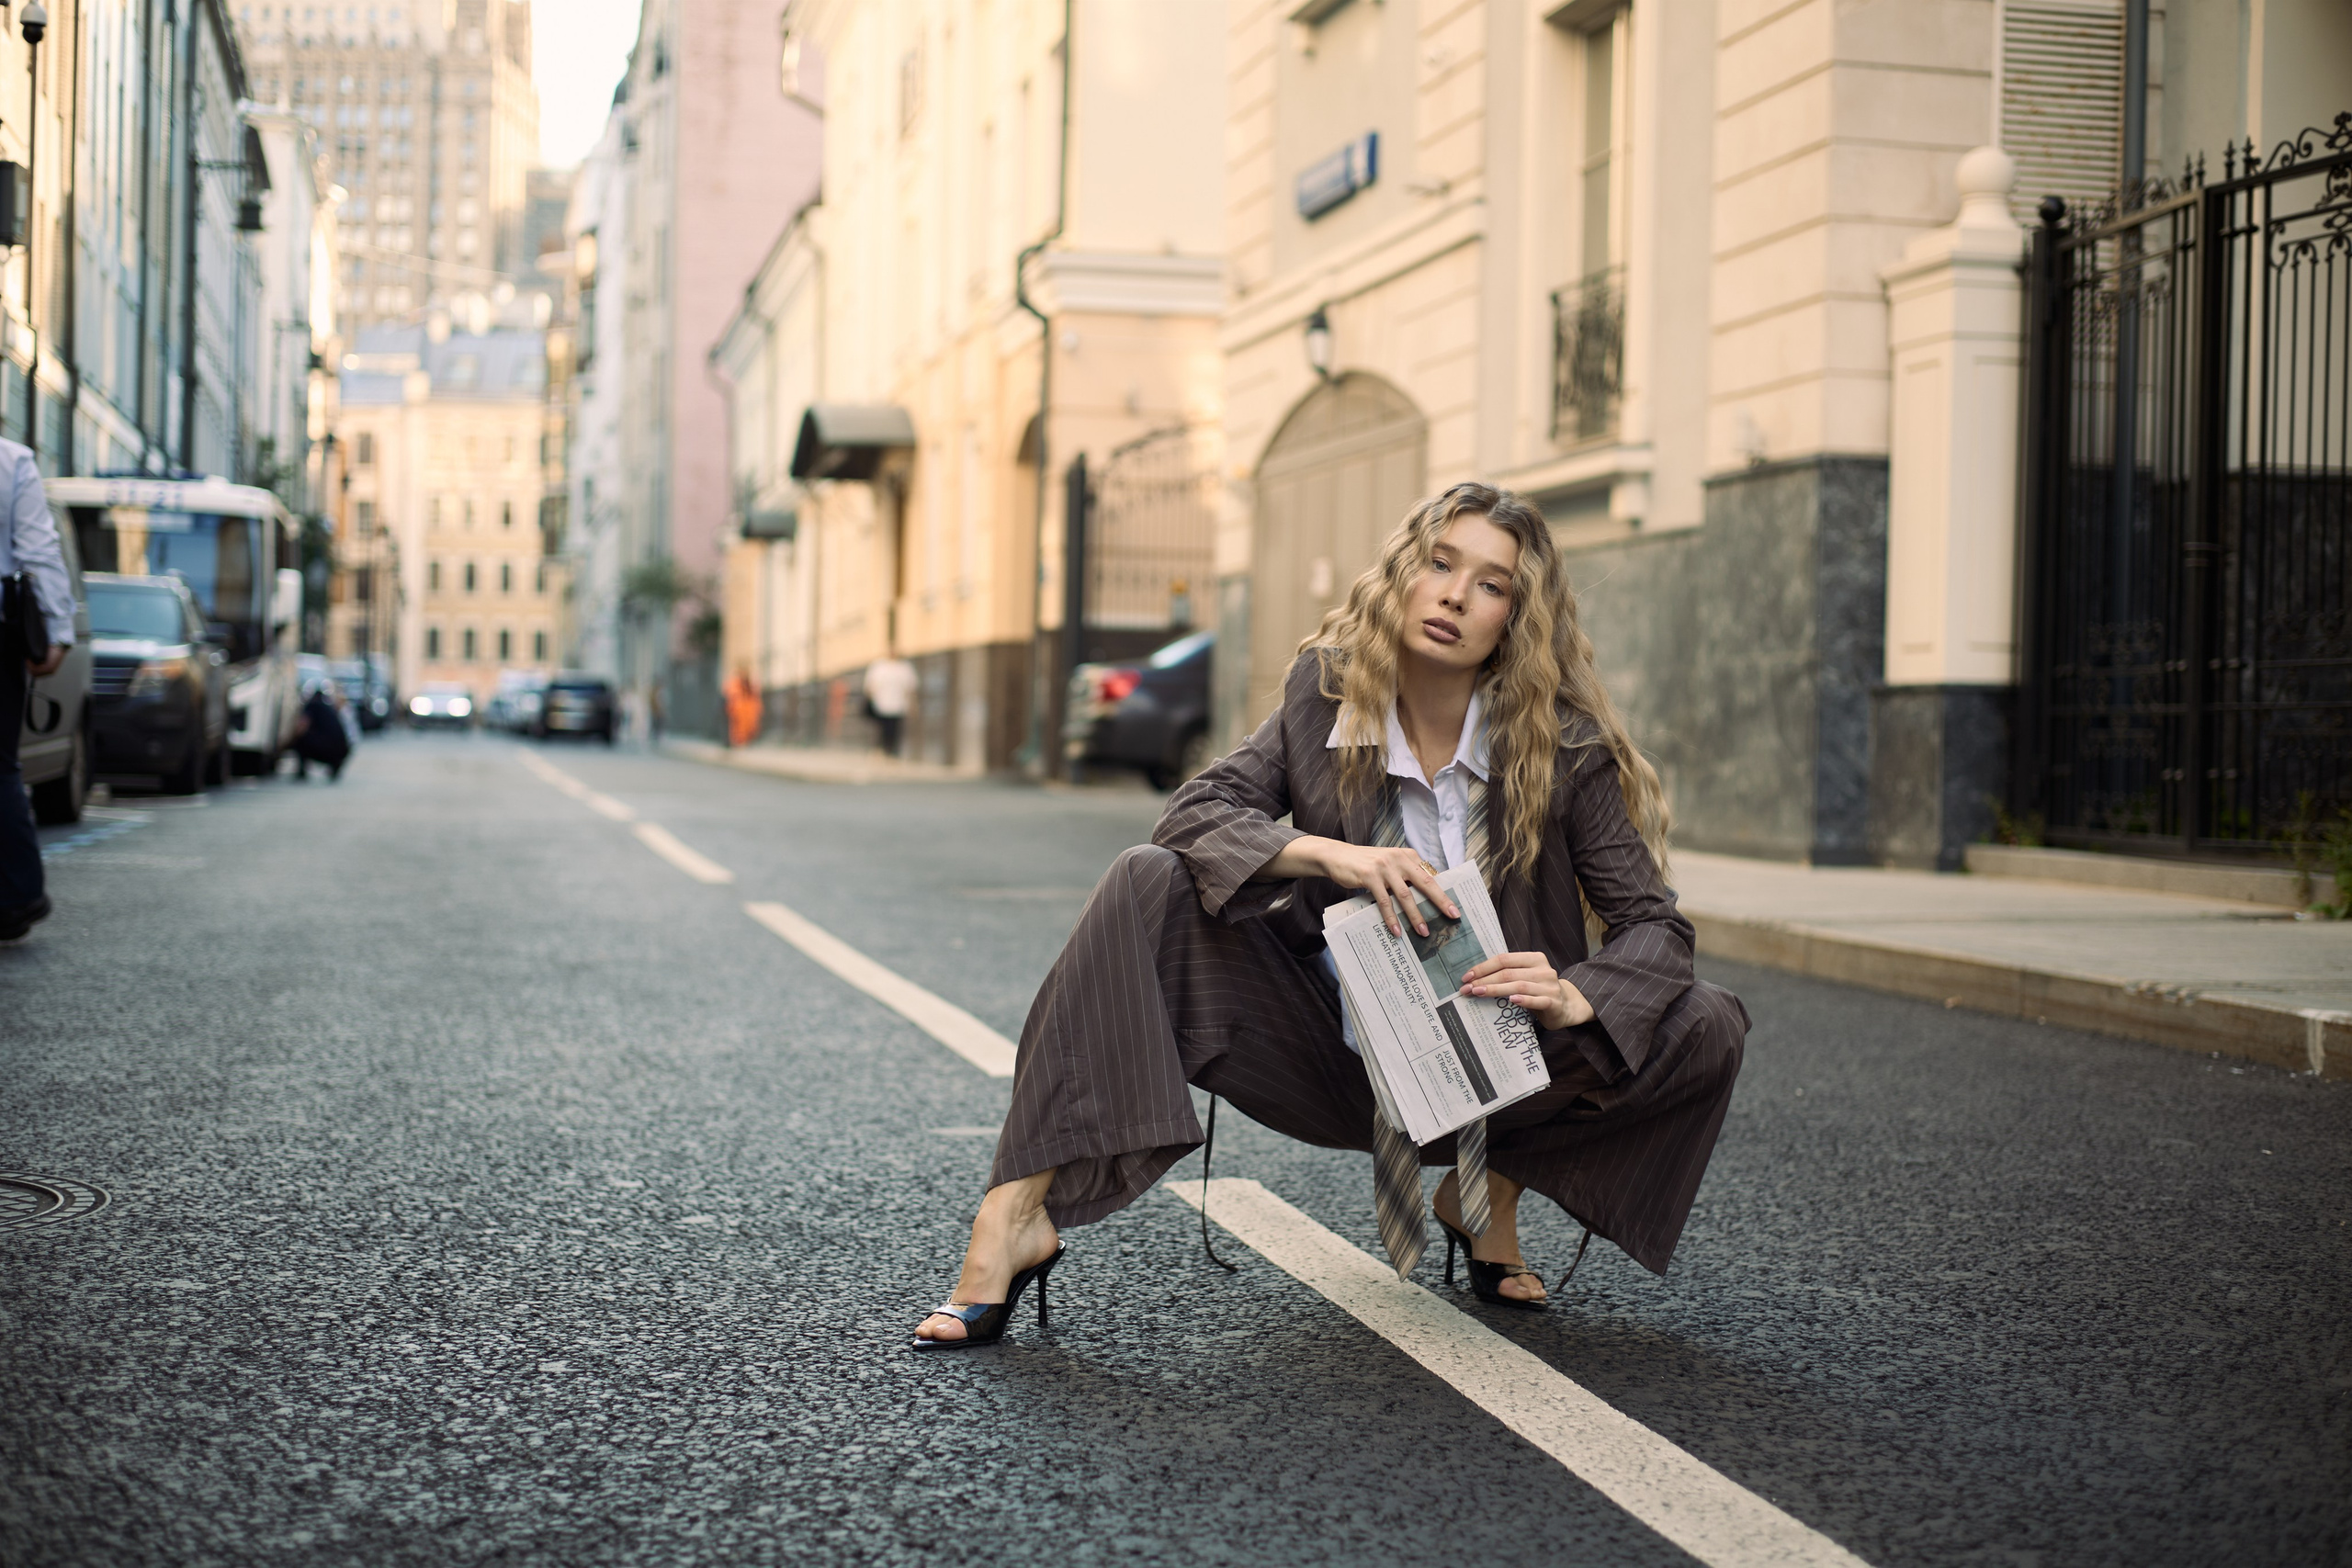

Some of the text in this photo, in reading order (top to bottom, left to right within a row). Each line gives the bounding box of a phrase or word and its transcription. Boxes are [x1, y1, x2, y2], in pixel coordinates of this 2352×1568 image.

[1372, 923, 1418, 1007] LIFE HATH IMMORTALITY.
[1382, 922, 1398, 949] ARGUE
[1394, 947, 1408, 966] THEE
[1402, 964, 1417, 985] THAT
[1411, 983, 1425, 1003] LOVE
[1419, 1001, 1429, 1010] IS
[1430, 1023, 1443, 1043] AND
[1491, 1015, 1518, 1053] VIEW
[1493, 992, 1520, 1031] OOD
[1510, 1028, 1528, 1049] AT
[1519, 1046, 1541, 1076] THE
[1521, 1026, 1542, 1055] THE
[1434, 1053, 1454, 1085] STRONG
[1442, 1048, 1474, 1105] JUST FROM THE
